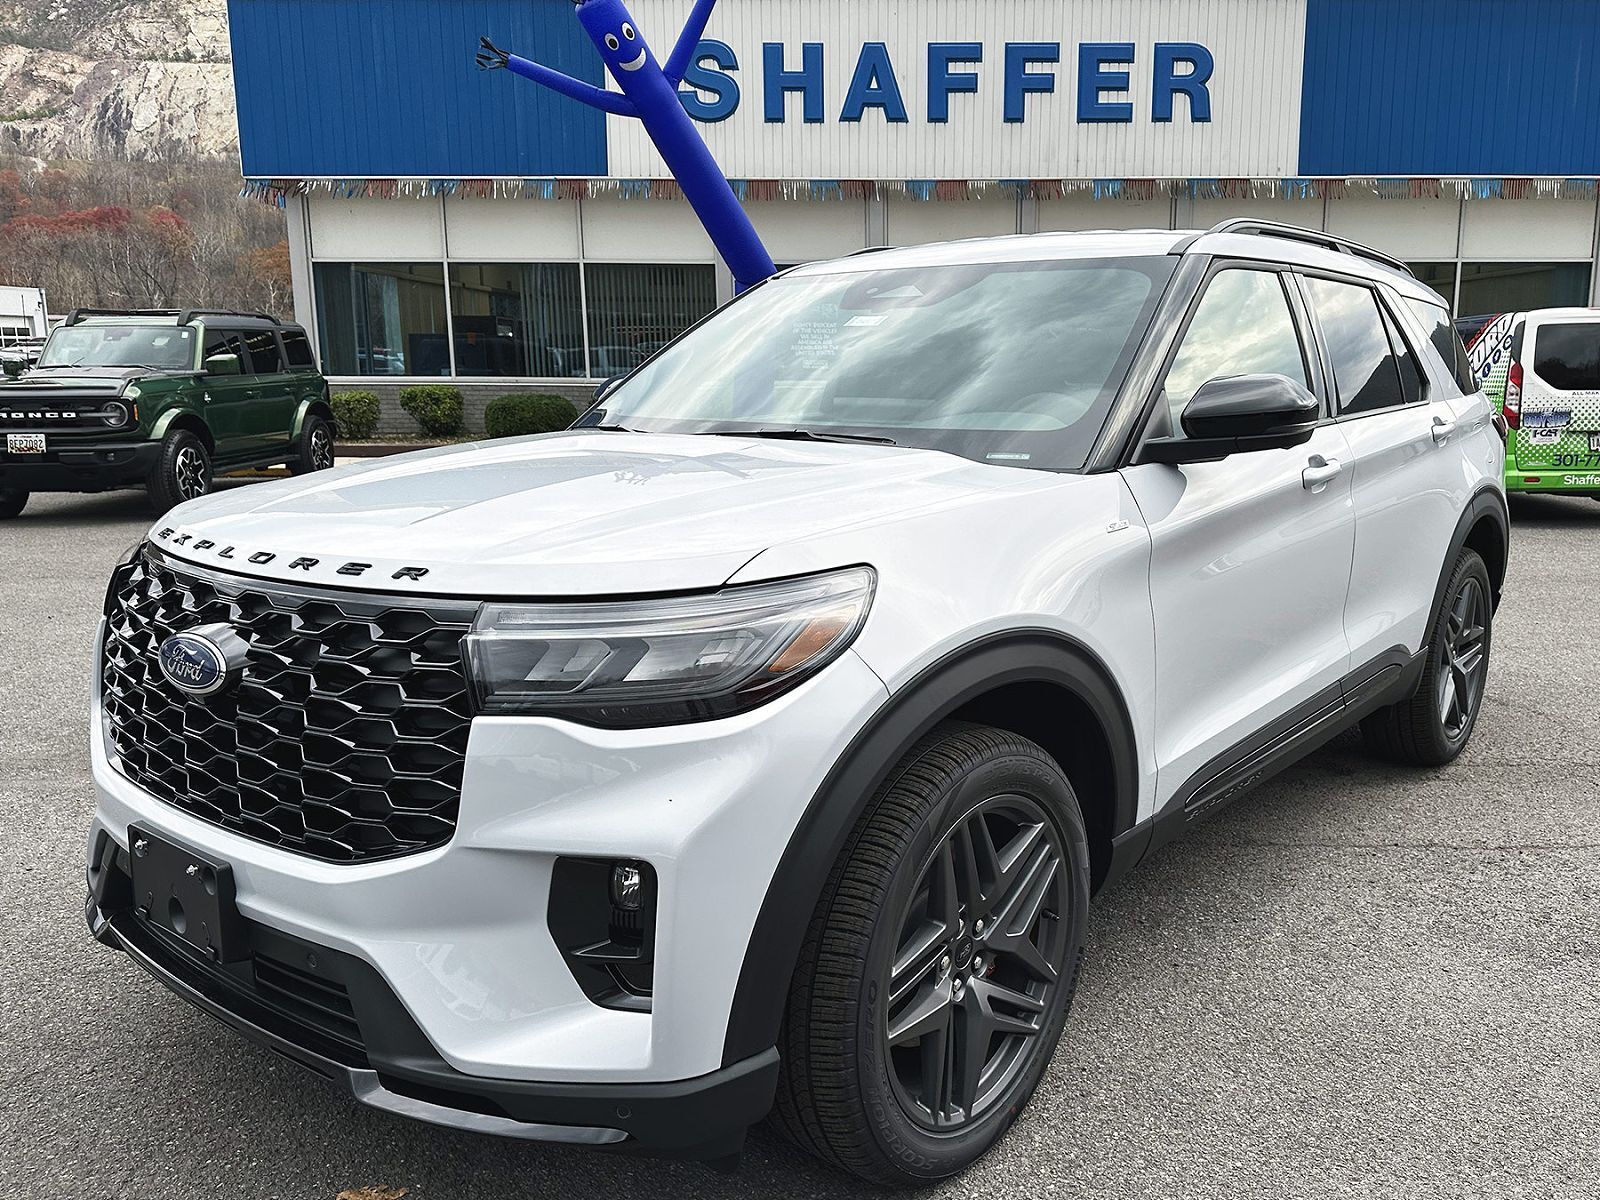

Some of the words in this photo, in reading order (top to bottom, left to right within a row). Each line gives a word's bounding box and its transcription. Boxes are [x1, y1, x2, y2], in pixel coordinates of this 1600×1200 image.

[678, 38, 1214, 123] SHAFFER
[158, 527, 430, 581] EXPLORER
[166, 645, 203, 682] Ford
